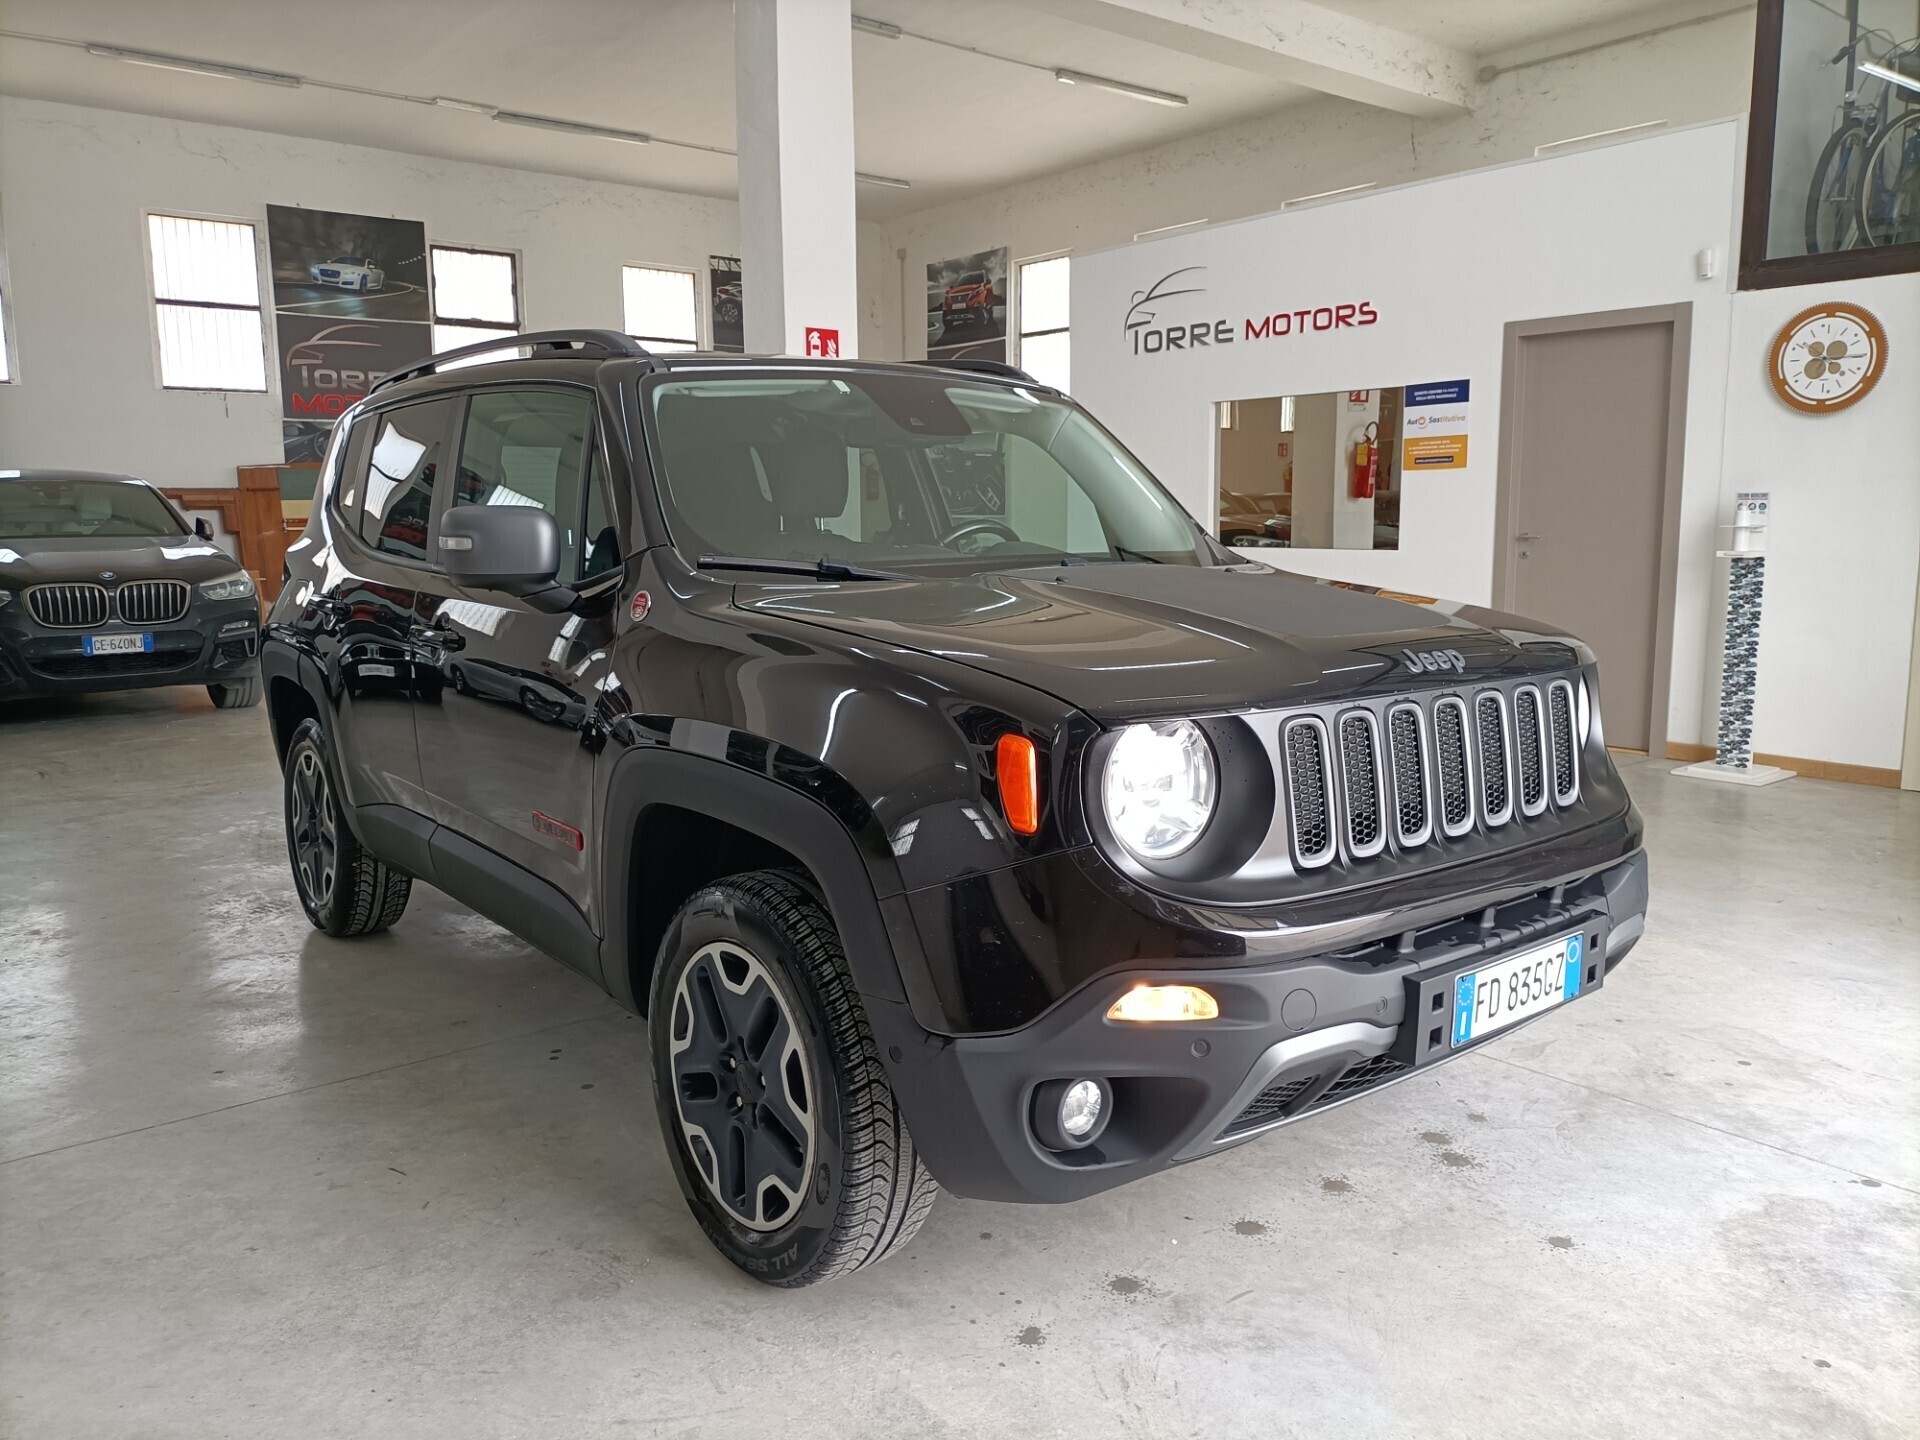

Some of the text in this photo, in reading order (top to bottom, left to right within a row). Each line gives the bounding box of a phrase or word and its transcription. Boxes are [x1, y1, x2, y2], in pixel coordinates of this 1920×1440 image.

[1126, 301, 1378, 355] TORRE MOTORS
[1401, 648, 1466, 674] Jeep
[1475, 977, 1501, 1024] FD
[771, 1242, 798, 1271] ALL
